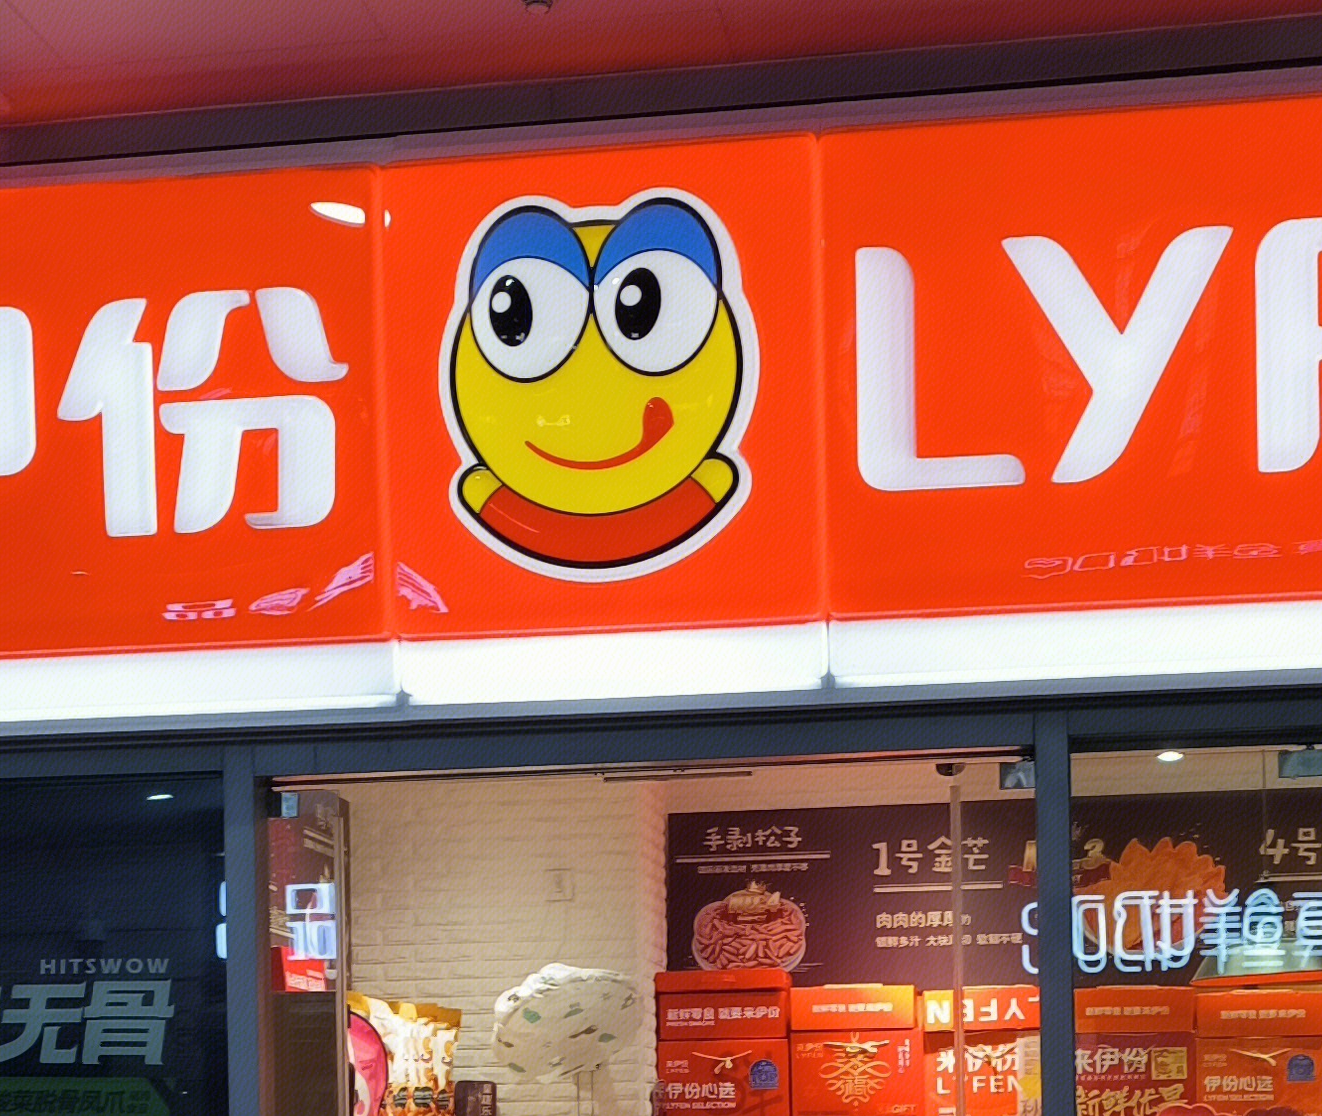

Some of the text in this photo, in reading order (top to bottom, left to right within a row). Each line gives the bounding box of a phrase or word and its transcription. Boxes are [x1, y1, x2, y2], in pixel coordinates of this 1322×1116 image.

[703, 825, 803, 851] 手剥松子
[39, 957, 171, 976] HITSWOW
[666, 1082, 736, 1099] 伊份心选
